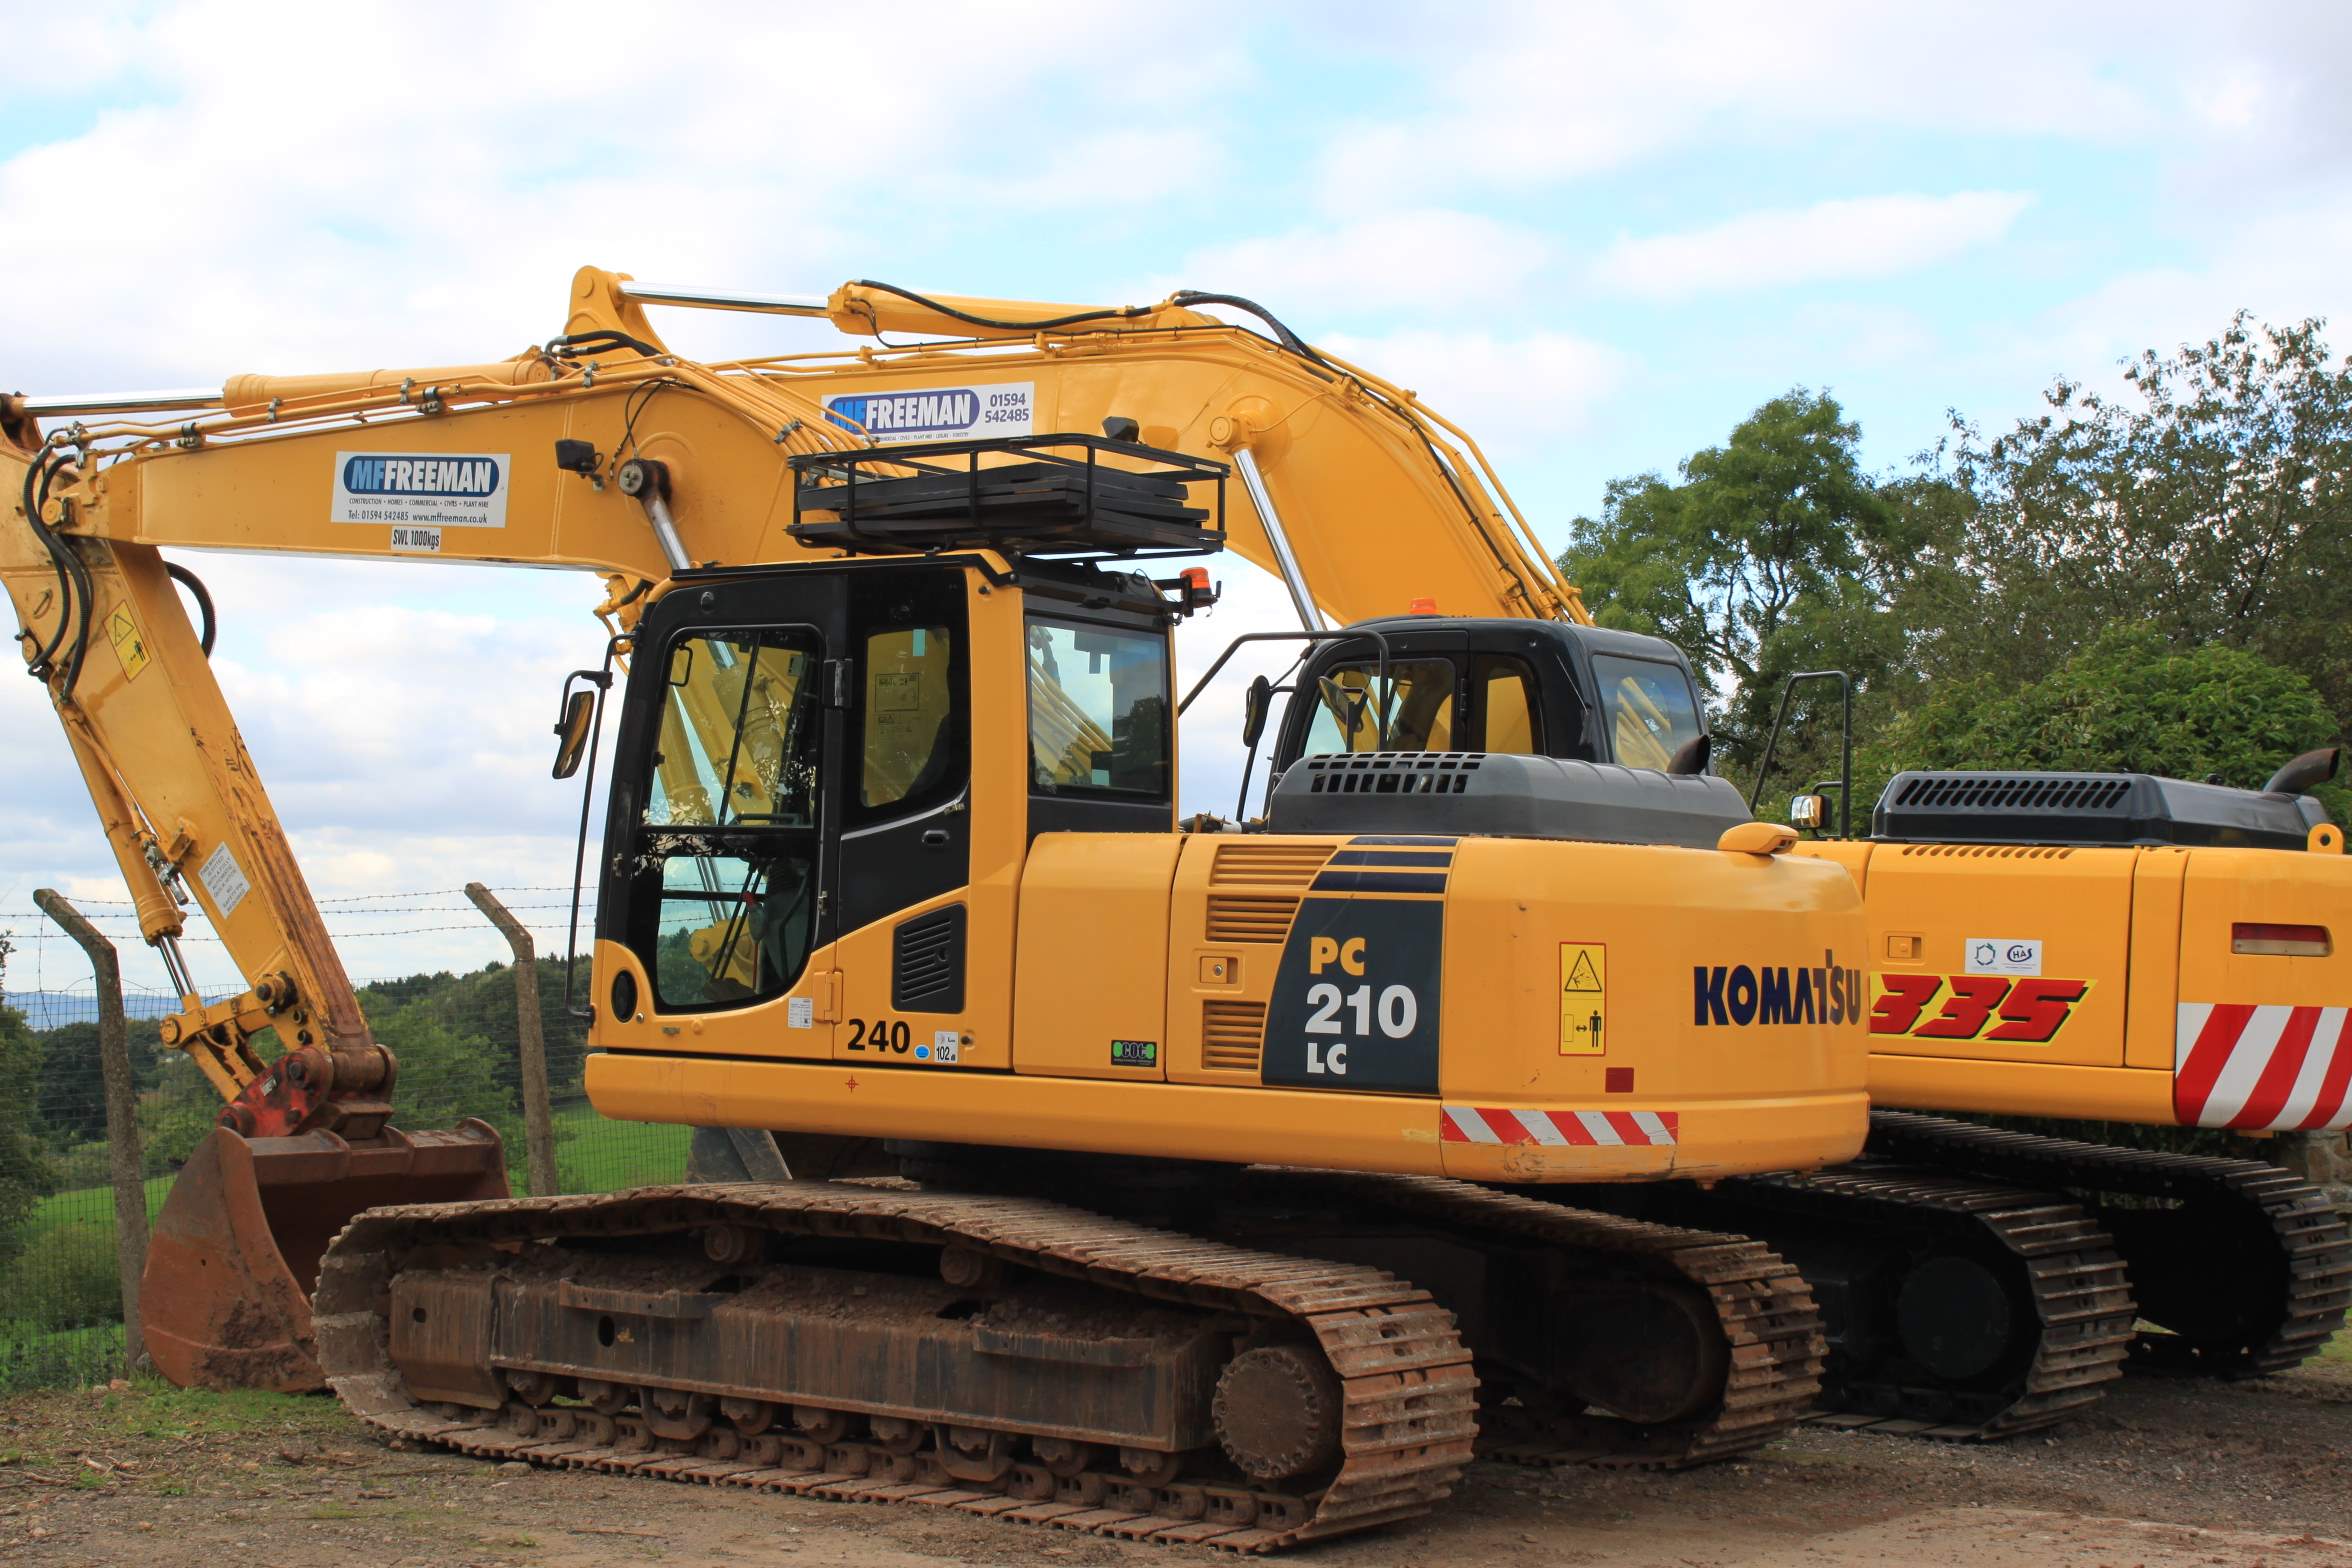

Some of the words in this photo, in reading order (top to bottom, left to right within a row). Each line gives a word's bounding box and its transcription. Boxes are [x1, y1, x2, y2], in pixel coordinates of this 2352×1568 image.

[990, 392, 1026, 407] 01594
[984, 408, 1030, 423] 542485
[348, 510, 360, 520] Tel:
[361, 510, 382, 520] 01594
[384, 511, 409, 521] 542485
[412, 511, 488, 524] www.mffreeman.co.uk
[393, 529, 408, 545] SWL
[411, 530, 440, 550] 1000kgs
[1309, 936, 1366, 976] PC
[2006, 944, 2033, 963] CHAS
[1693, 948, 1862, 1027] KOMATSU
[1304, 982, 1418, 1039] 210
[1869, 973, 2090, 1043] 335
[847, 1018, 911, 1054] 240
[936, 1045, 950, 1061] 102
[1306, 1042, 1348, 1075] LC
